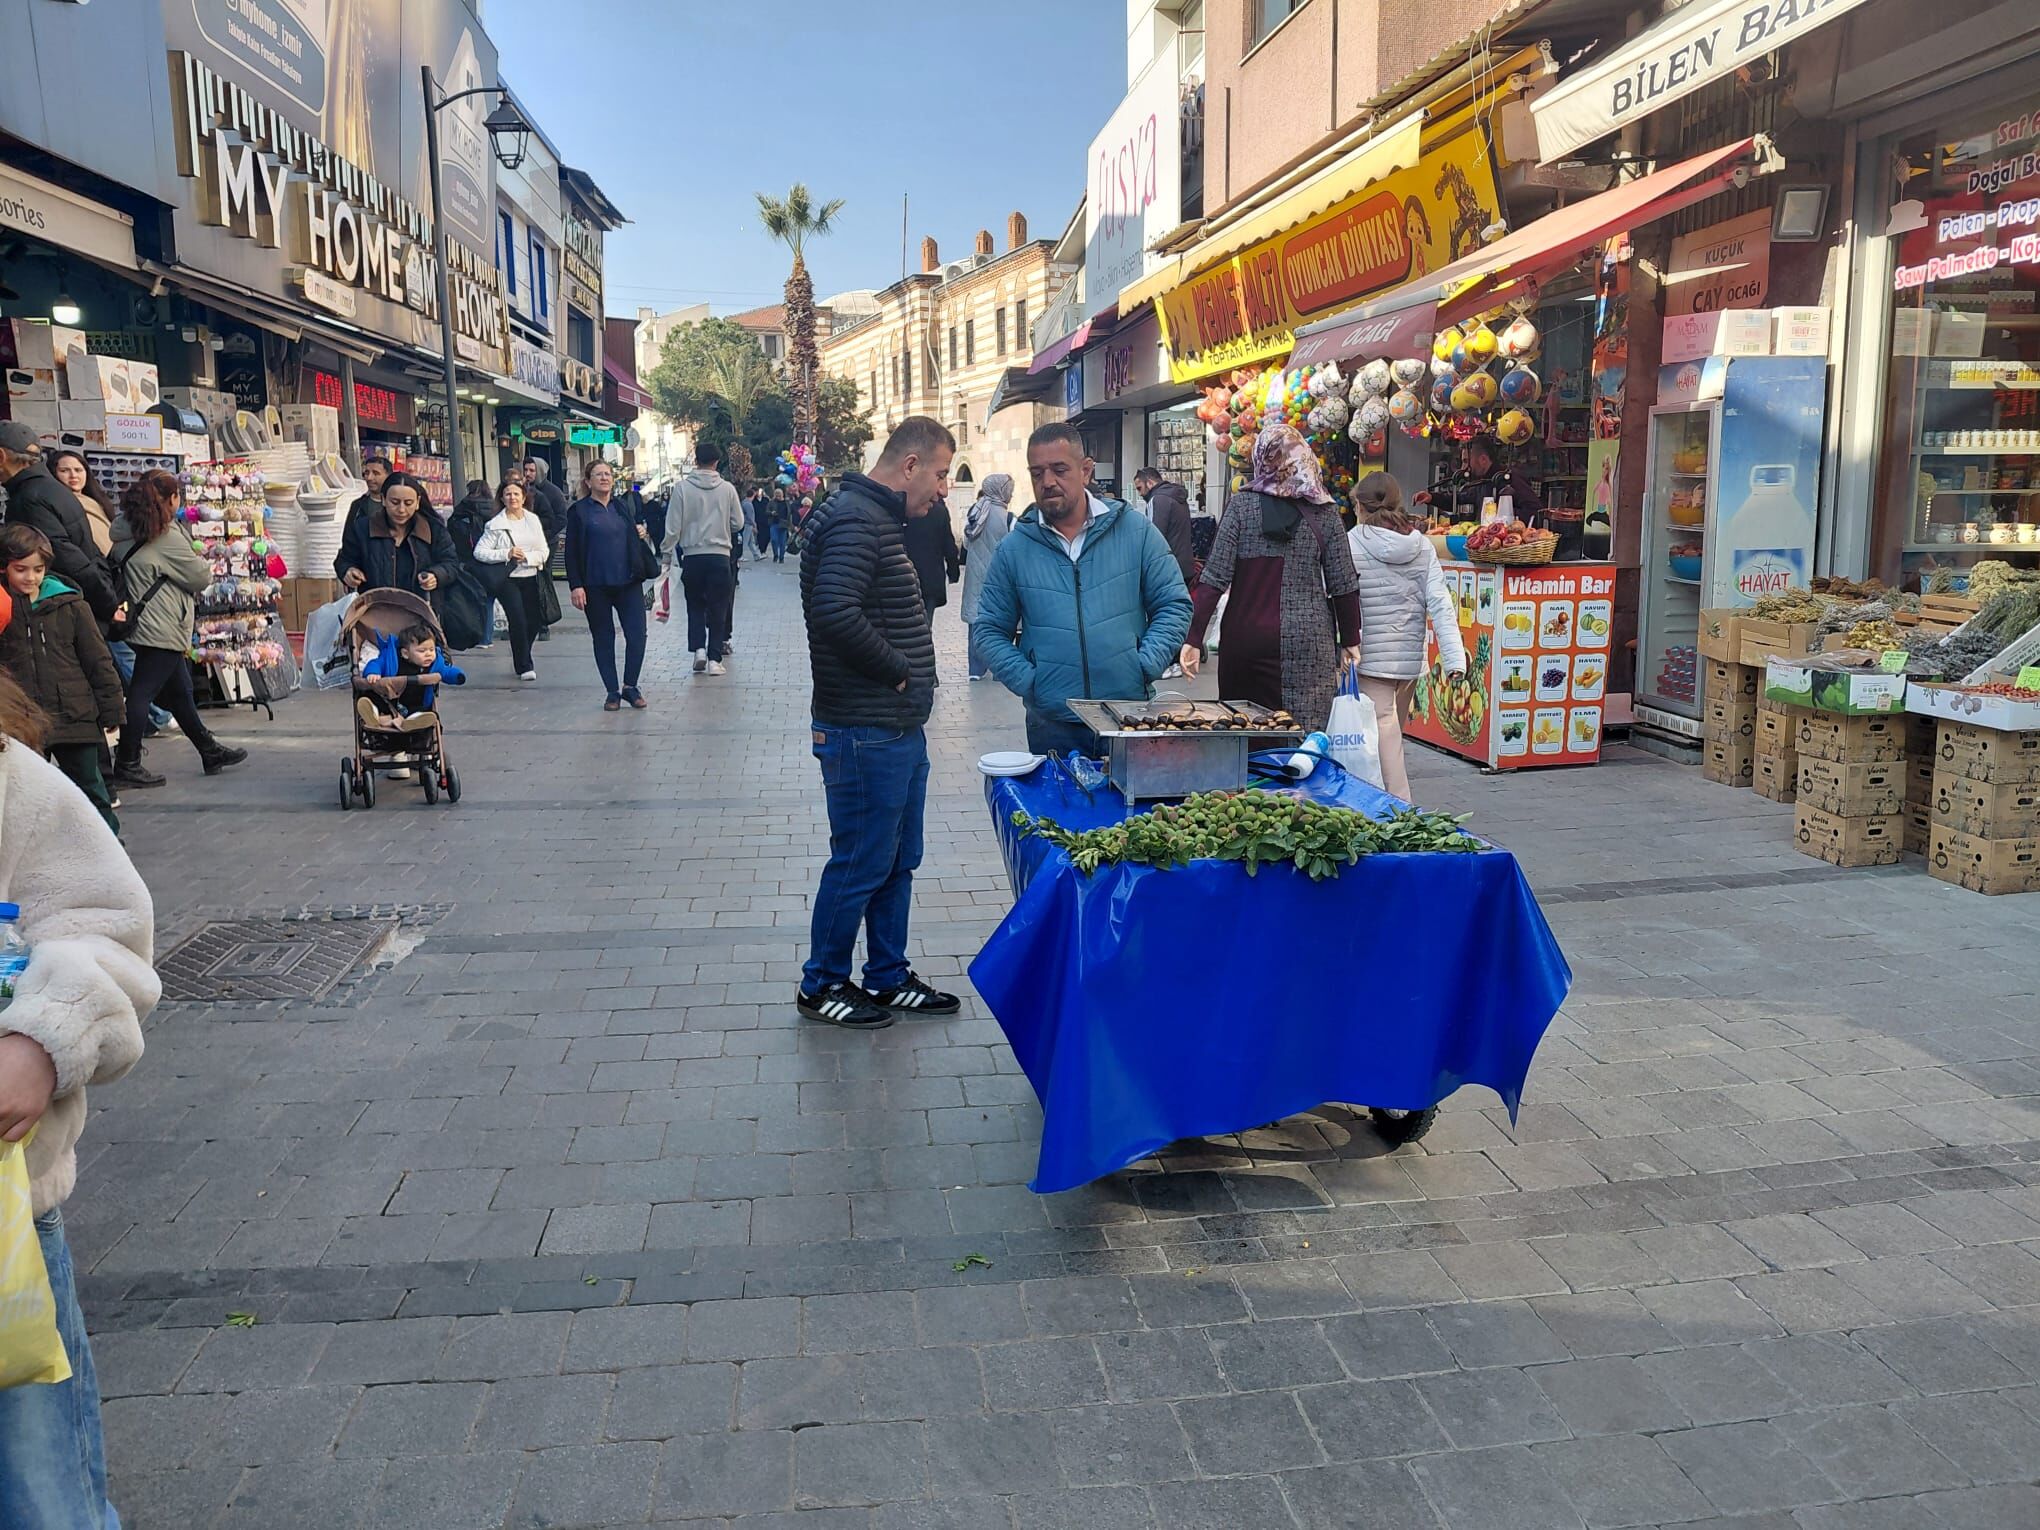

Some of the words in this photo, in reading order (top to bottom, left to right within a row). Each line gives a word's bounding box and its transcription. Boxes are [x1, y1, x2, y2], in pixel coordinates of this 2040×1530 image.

[1611, 28, 1721, 116] BİLEN
[1998, 114, 2028, 146] Saf
[1967, 157, 2018, 194] Doğal
[215, 128, 289, 249] MY
[307, 181, 404, 303] HOME
[1939, 213, 1985, 242] Polen
[1286, 236, 1345, 299] OYUNCAK
[1340, 207, 1405, 278] DÜNYASI
[1705, 241, 1745, 264] KÜÇÜK
[1895, 264, 1928, 290] Saw
[1927, 244, 1998, 282] Palmetto
[421, 251, 439, 320] M
[455, 272, 504, 349] HOME
[1191, 247, 1288, 352] KEMERALTI
[1728, 281, 1761, 302] OCAĞI
[1208, 345, 1243, 366] TOPTAN
[232, 383, 250, 393] MY
[236, 394, 260, 404] OME
[117, 418, 151, 427] GÖZLÜK
[121, 432, 137, 440] 500
[1507, 574, 1576, 595] Vitamin
[1580, 575, 1612, 594] Bar
[1739, 572, 1791, 593] HAYAT
